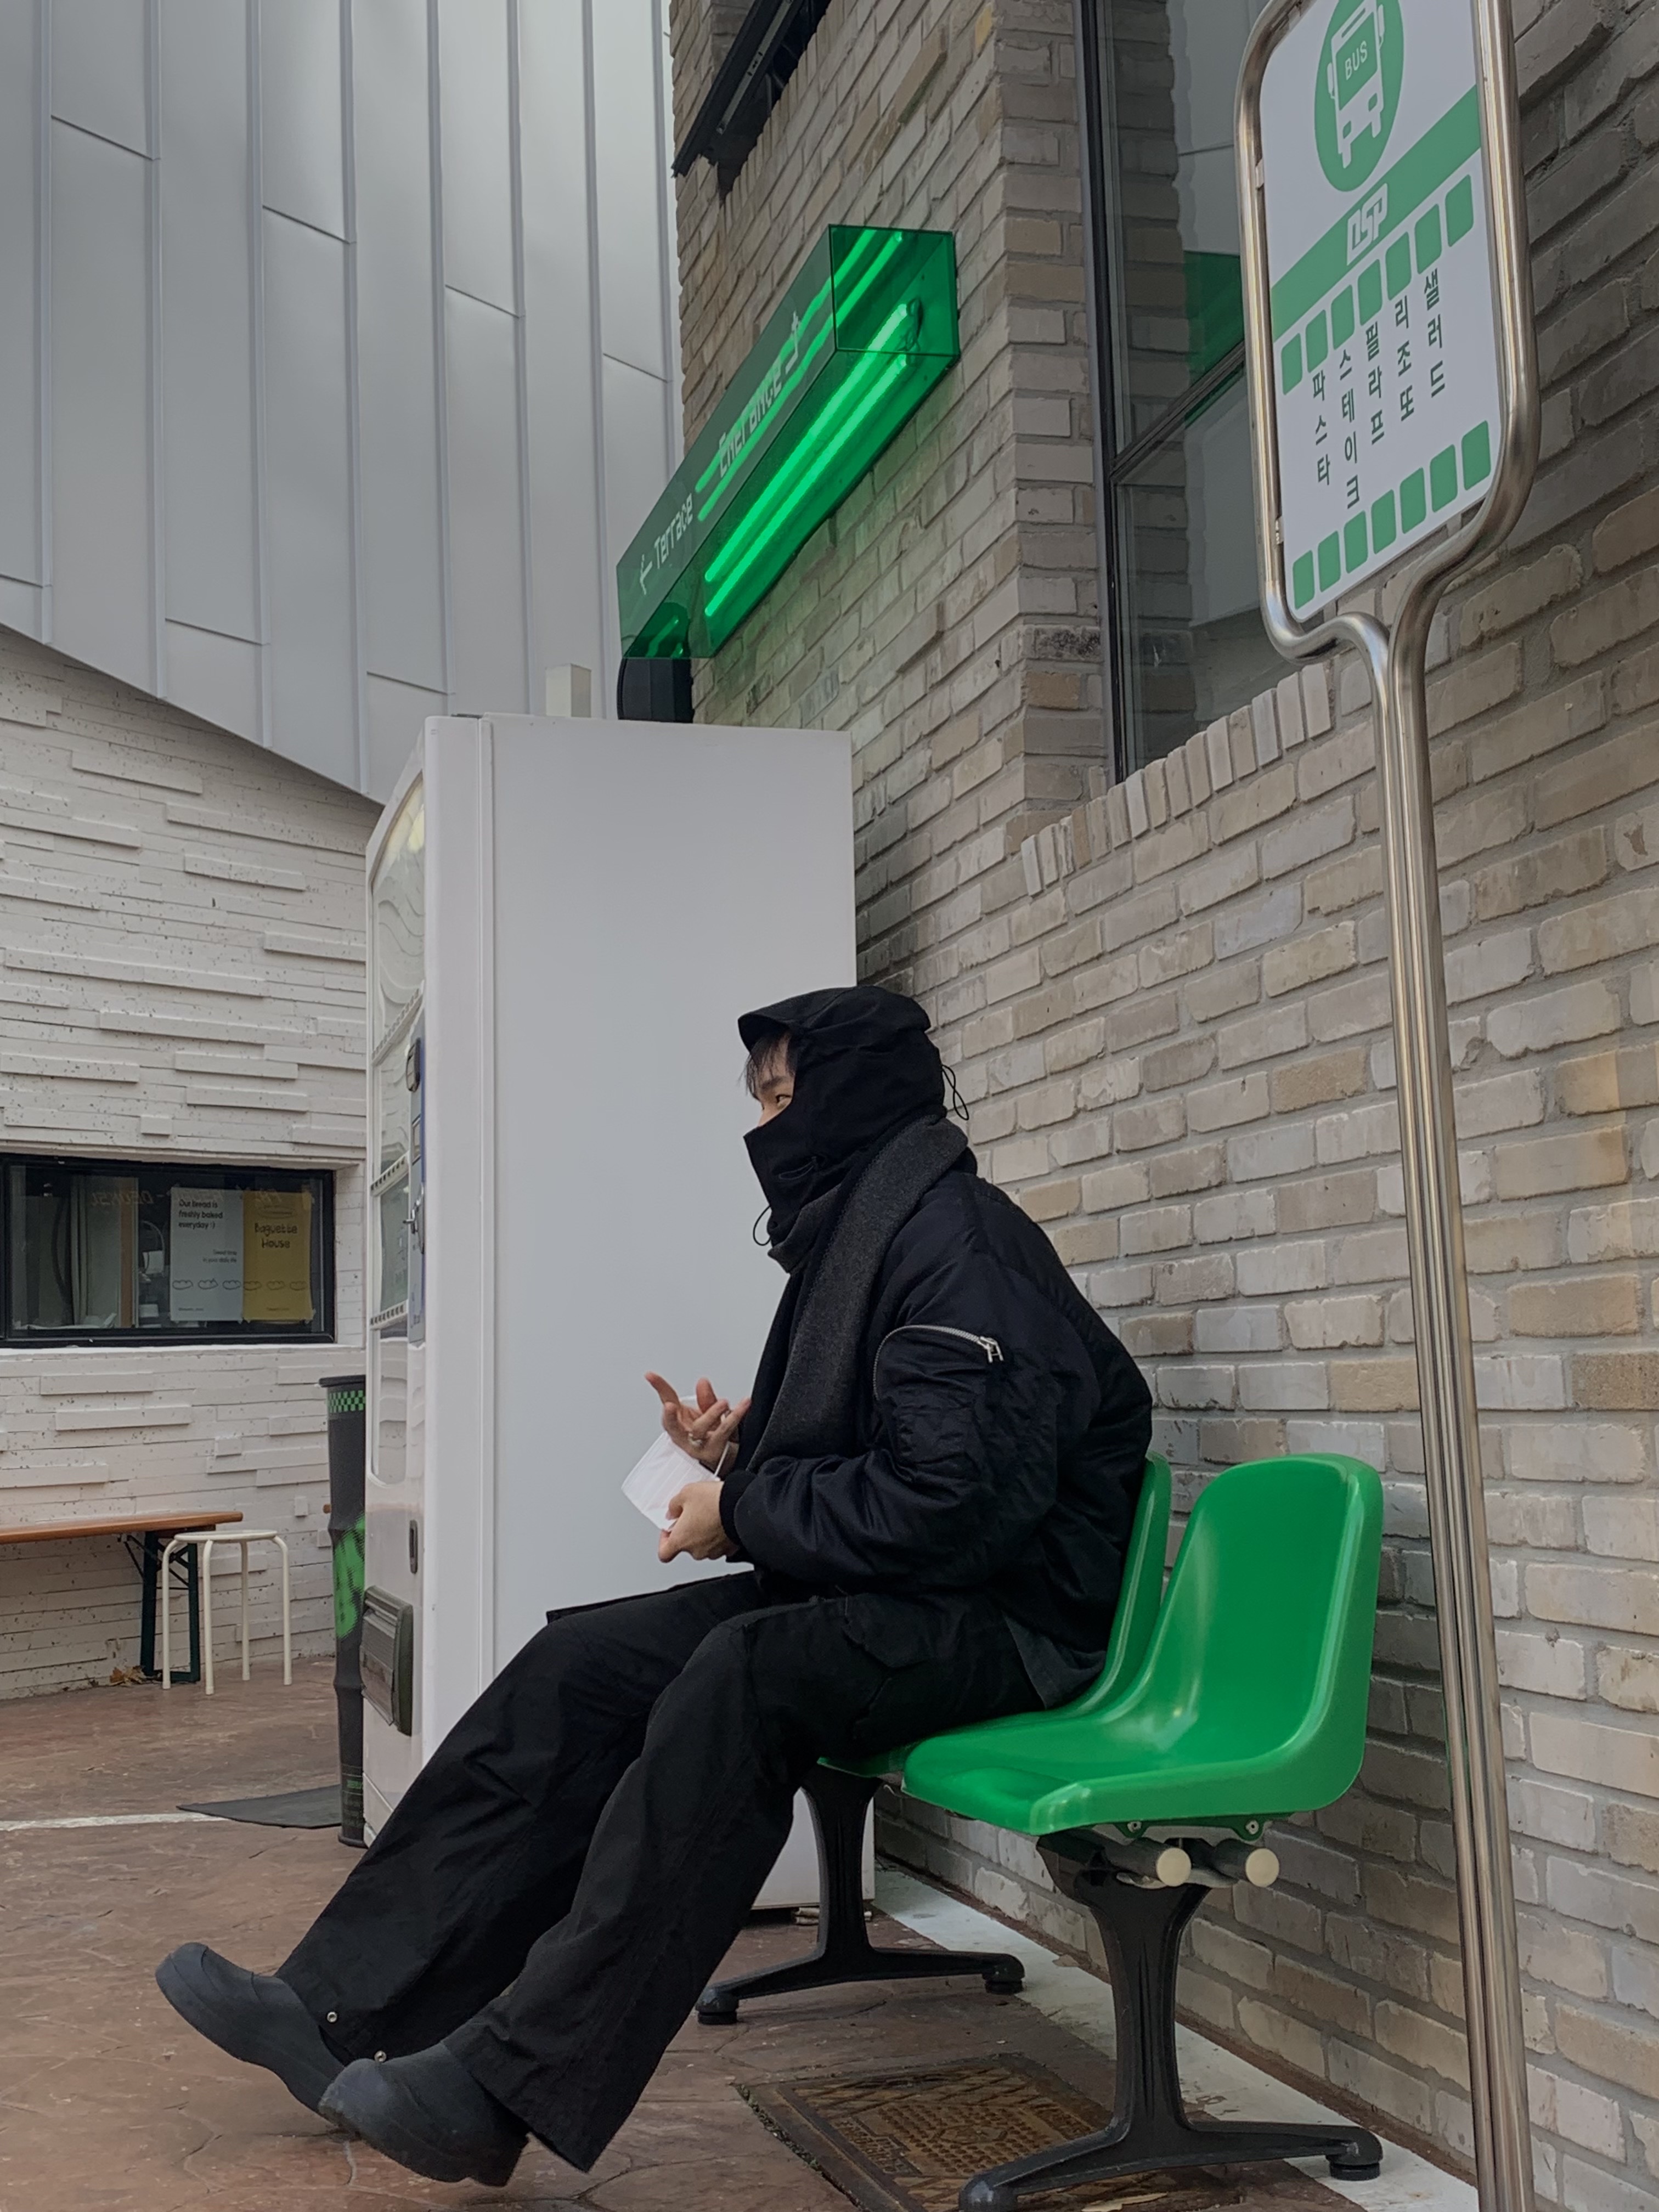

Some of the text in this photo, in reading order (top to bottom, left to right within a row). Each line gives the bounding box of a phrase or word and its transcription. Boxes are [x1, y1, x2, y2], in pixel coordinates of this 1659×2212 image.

[1345, 41, 1368, 81] BUS
[1395, 295, 1414, 422] 리조또
[1424, 267, 1446, 398] 샐러드
[1365, 321, 1385, 445] 필라프
[1312, 369, 1331, 486] 파스타
[1339, 349, 1360, 510] 스테이크
[654, 493, 693, 569] Terrace
[178, 1199, 218, 1209] Our bread is
[178, 1210, 223, 1219] freshly baked
[178, 1221, 209, 1230] everyday
[254, 1222, 298, 1237] Baguette
[261, 1237, 291, 1249] House
